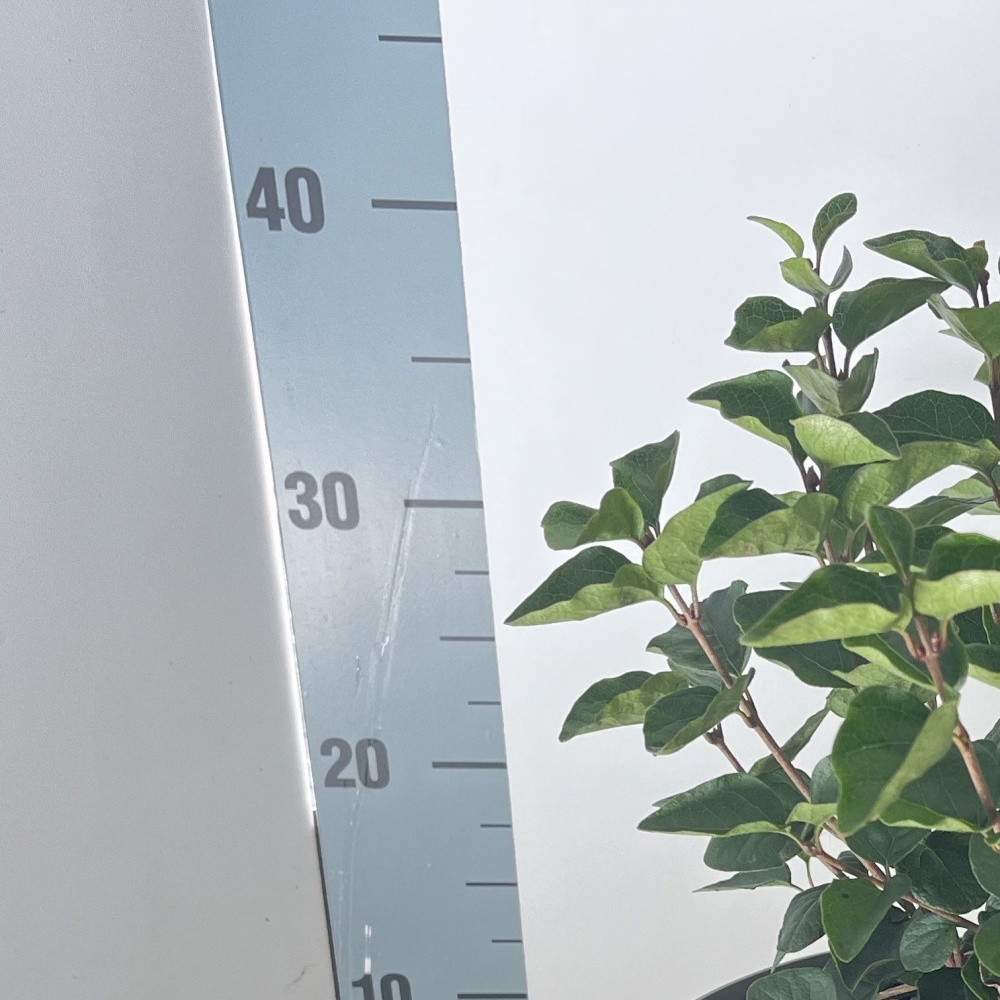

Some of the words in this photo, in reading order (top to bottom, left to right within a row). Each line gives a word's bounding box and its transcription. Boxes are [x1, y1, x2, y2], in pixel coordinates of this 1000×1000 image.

[246, 166, 325, 234] 40
[284, 471, 360, 531] 30
[320, 738, 390, 789] 20
